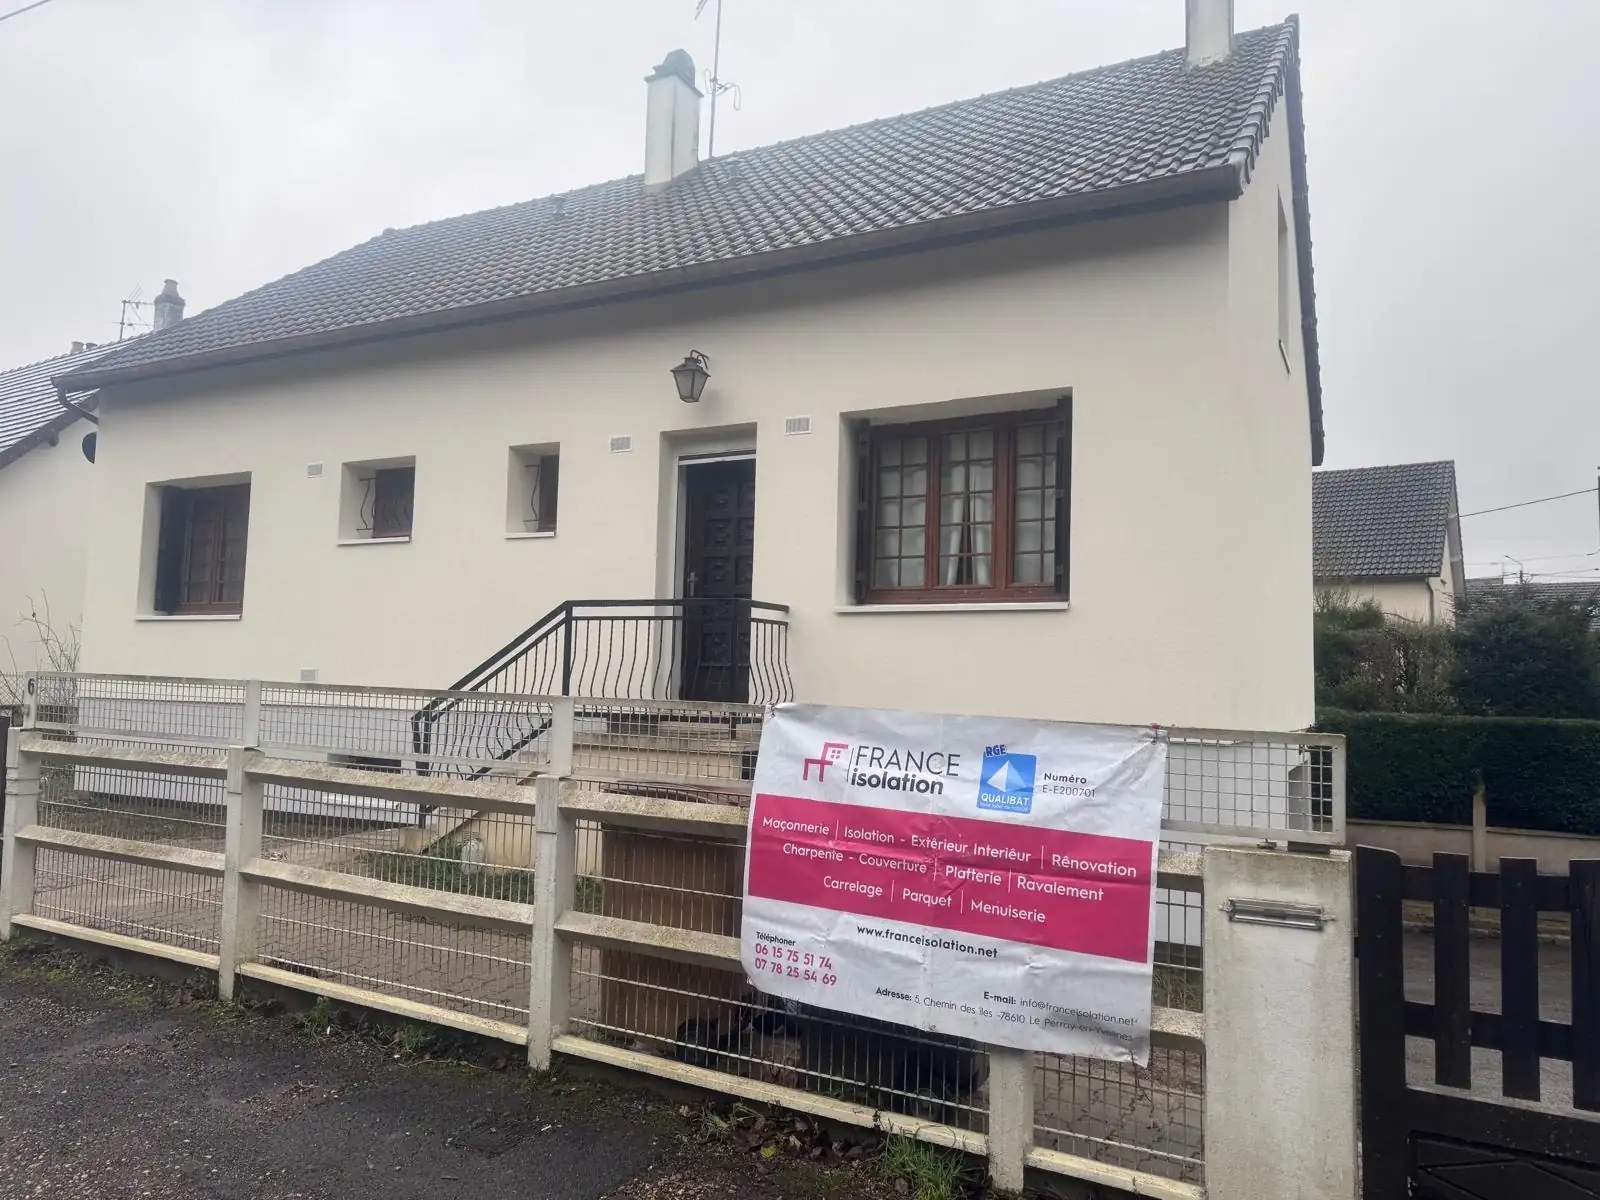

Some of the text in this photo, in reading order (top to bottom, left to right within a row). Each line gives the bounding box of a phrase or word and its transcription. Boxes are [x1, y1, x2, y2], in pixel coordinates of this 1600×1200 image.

[27, 678, 35, 695] 6
[855, 745, 961, 777] FRANCE
[985, 744, 1007, 757] RGE
[851, 768, 943, 795] isolation
[1042, 785, 1095, 798] E-E200701
[1043, 772, 1087, 784] Numéro
[981, 793, 1029, 806] QUALIBAT
[762, 816, 830, 835] Maçonnerie
[844, 826, 895, 844] Isolation
[783, 843, 844, 862] Charpente
[858, 853, 927, 874] Couverture
[945, 865, 1002, 885] Platterie
[1017, 875, 1104, 901] Ravalement
[823, 875, 1046, 923] Carrelage Parquet Menuiserie
[857, 926, 998, 958] www.franceisolation.net
[755, 943, 832, 970] 06 15 75 51 74
[755, 958, 837, 986] 07 78 25 54 69
[875, 987, 912, 1001] Adresse:
[923, 997, 957, 1011] Chemin
[960, 1003, 976, 1015] des
[996, 1011, 1025, 1024] -78610
[1029, 1016, 1040, 1025] Le
[983, 991, 1016, 1005] E-mail:
